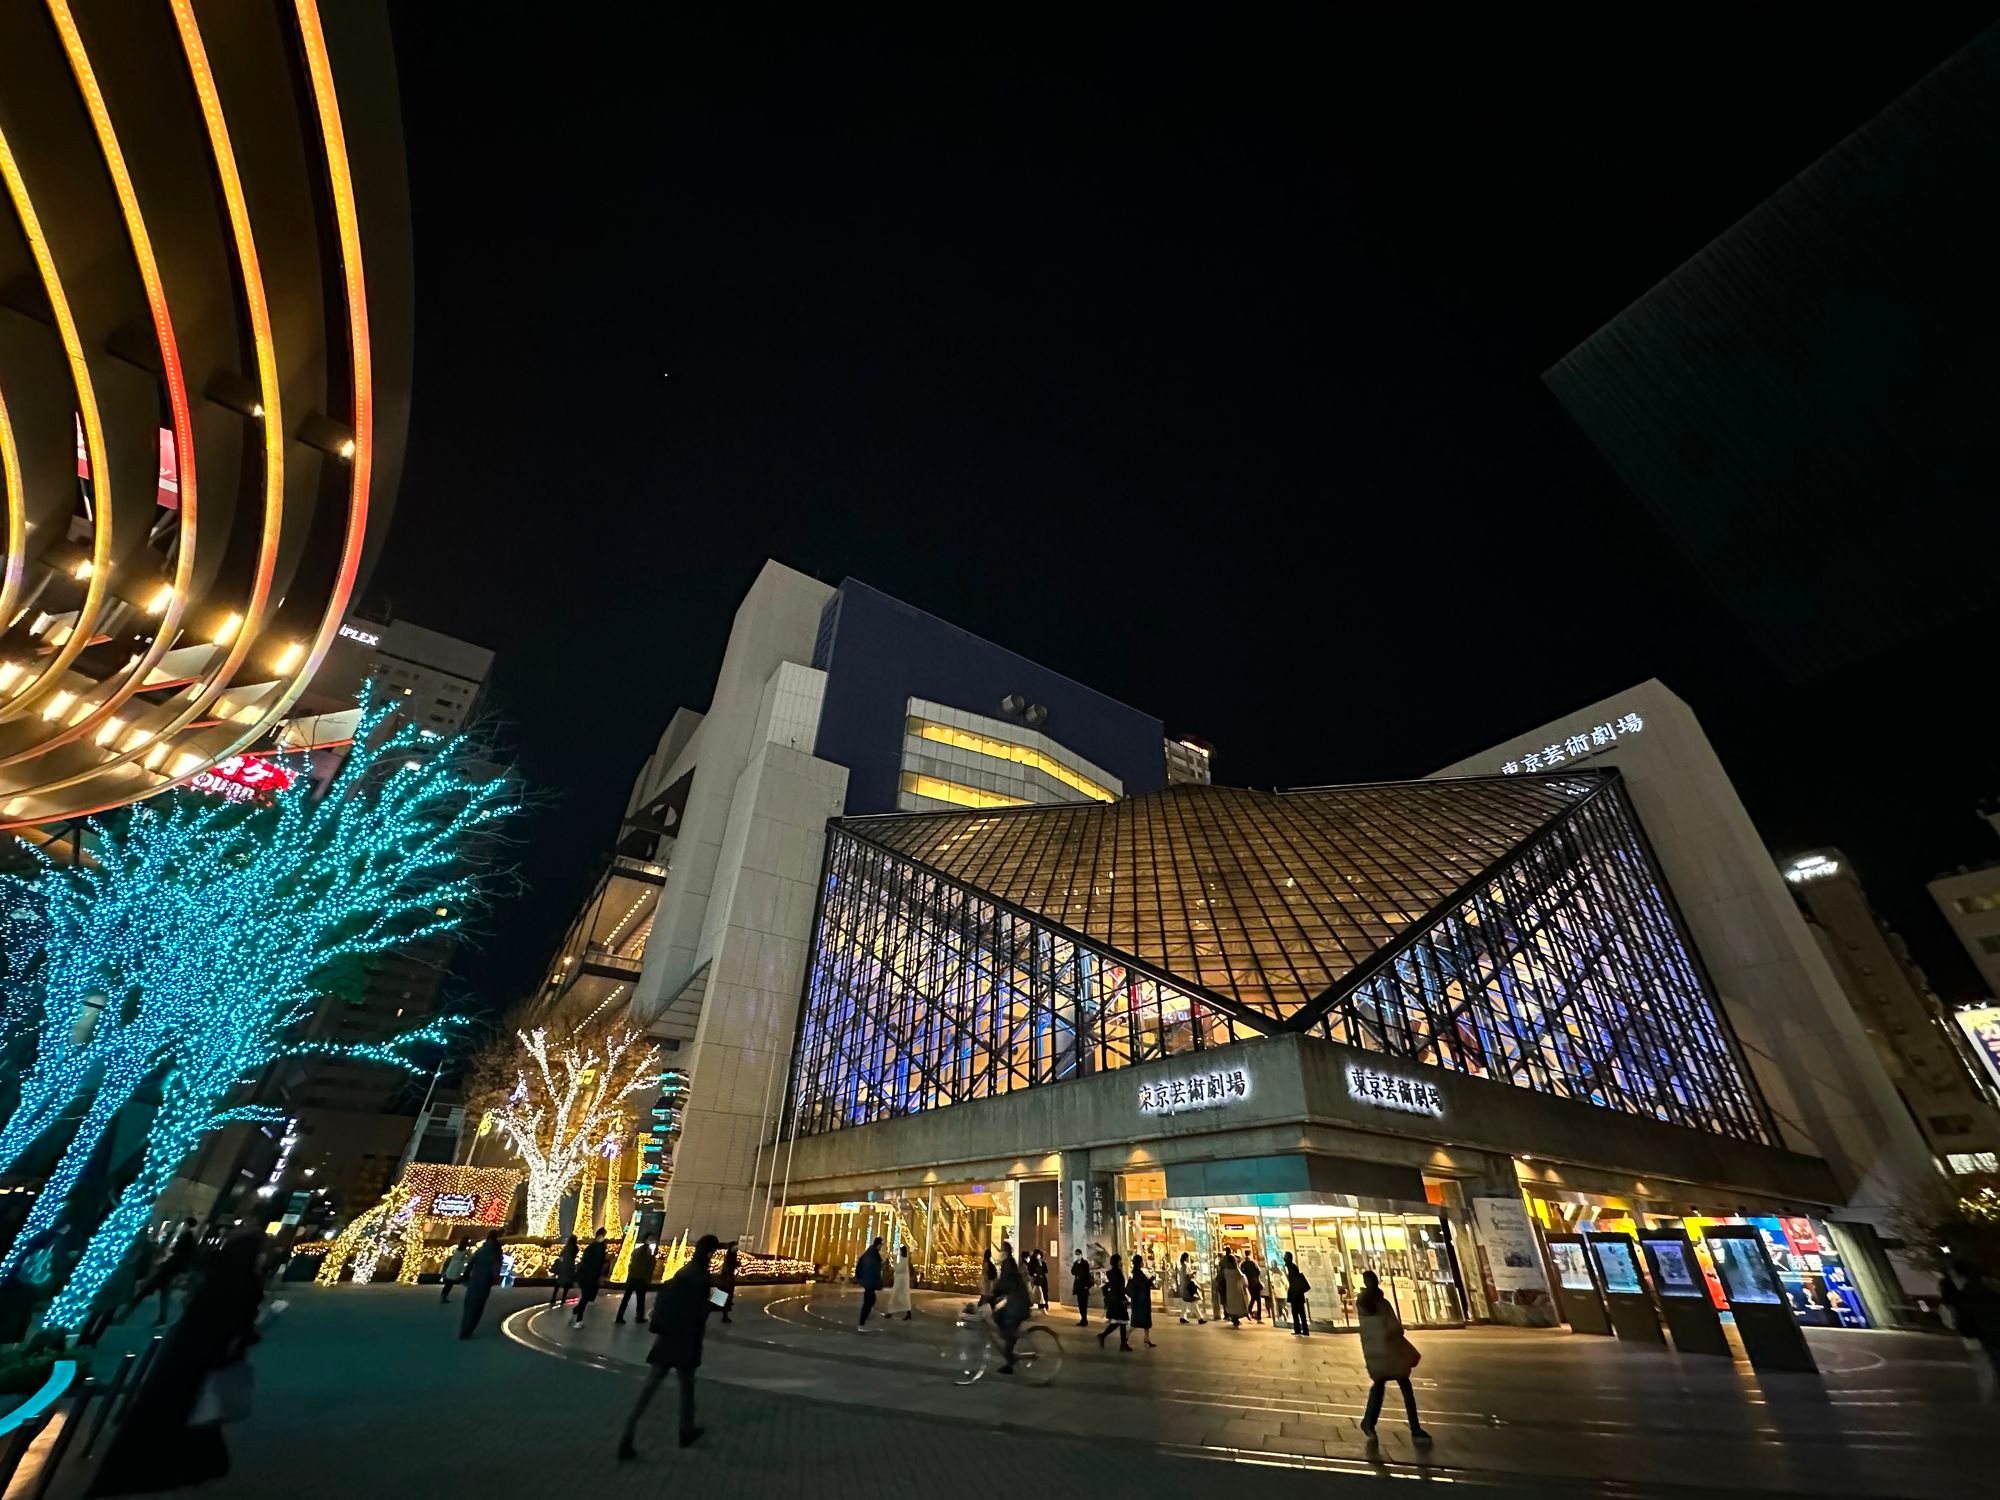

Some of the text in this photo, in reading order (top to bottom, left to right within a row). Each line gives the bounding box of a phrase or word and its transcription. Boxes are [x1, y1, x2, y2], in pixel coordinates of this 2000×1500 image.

[1138, 1070, 1246, 1111] 東京芸術劇場
[1352, 1069, 1444, 1112] 東京芸術劇場
